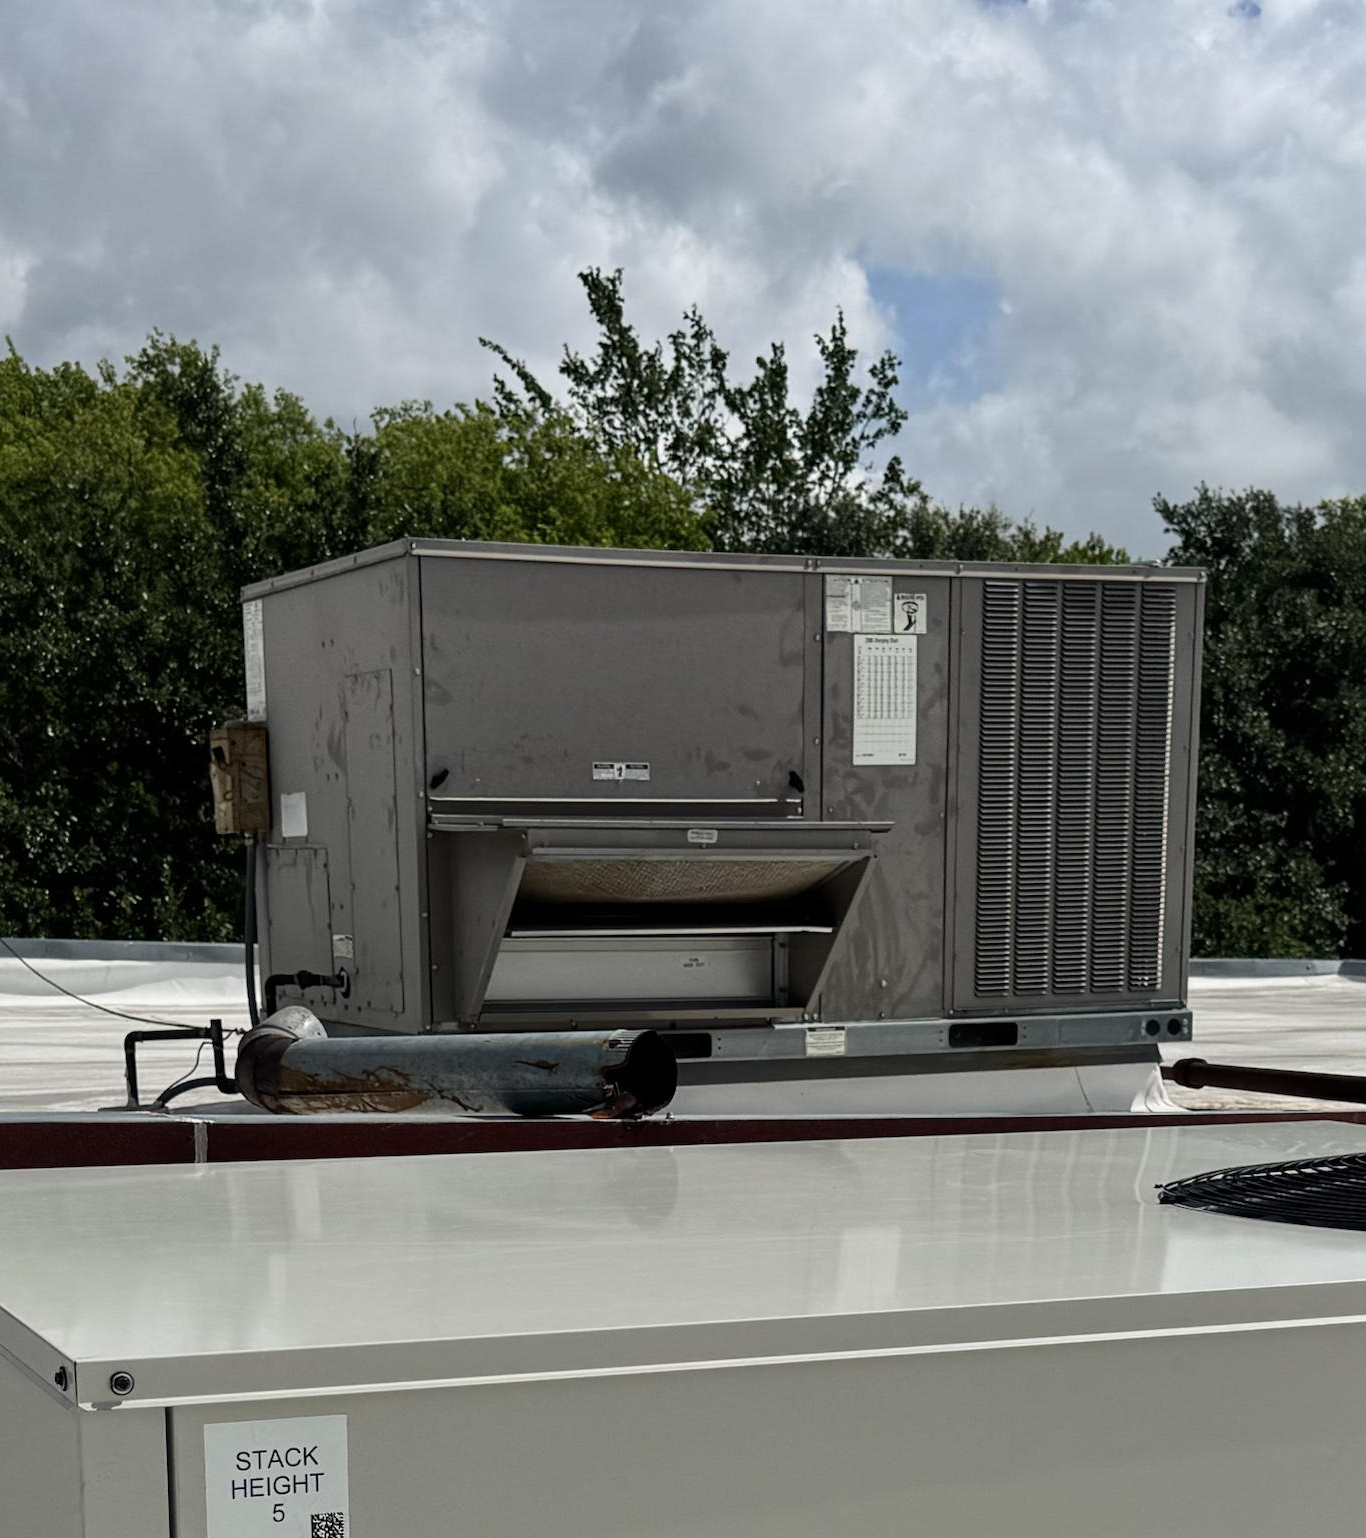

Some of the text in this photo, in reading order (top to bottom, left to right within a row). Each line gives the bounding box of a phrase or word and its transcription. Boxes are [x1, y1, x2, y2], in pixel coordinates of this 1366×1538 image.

[236, 1446, 319, 1471] STACK
[231, 1472, 325, 1500] HEIGHT
[272, 1503, 285, 1522] 5
